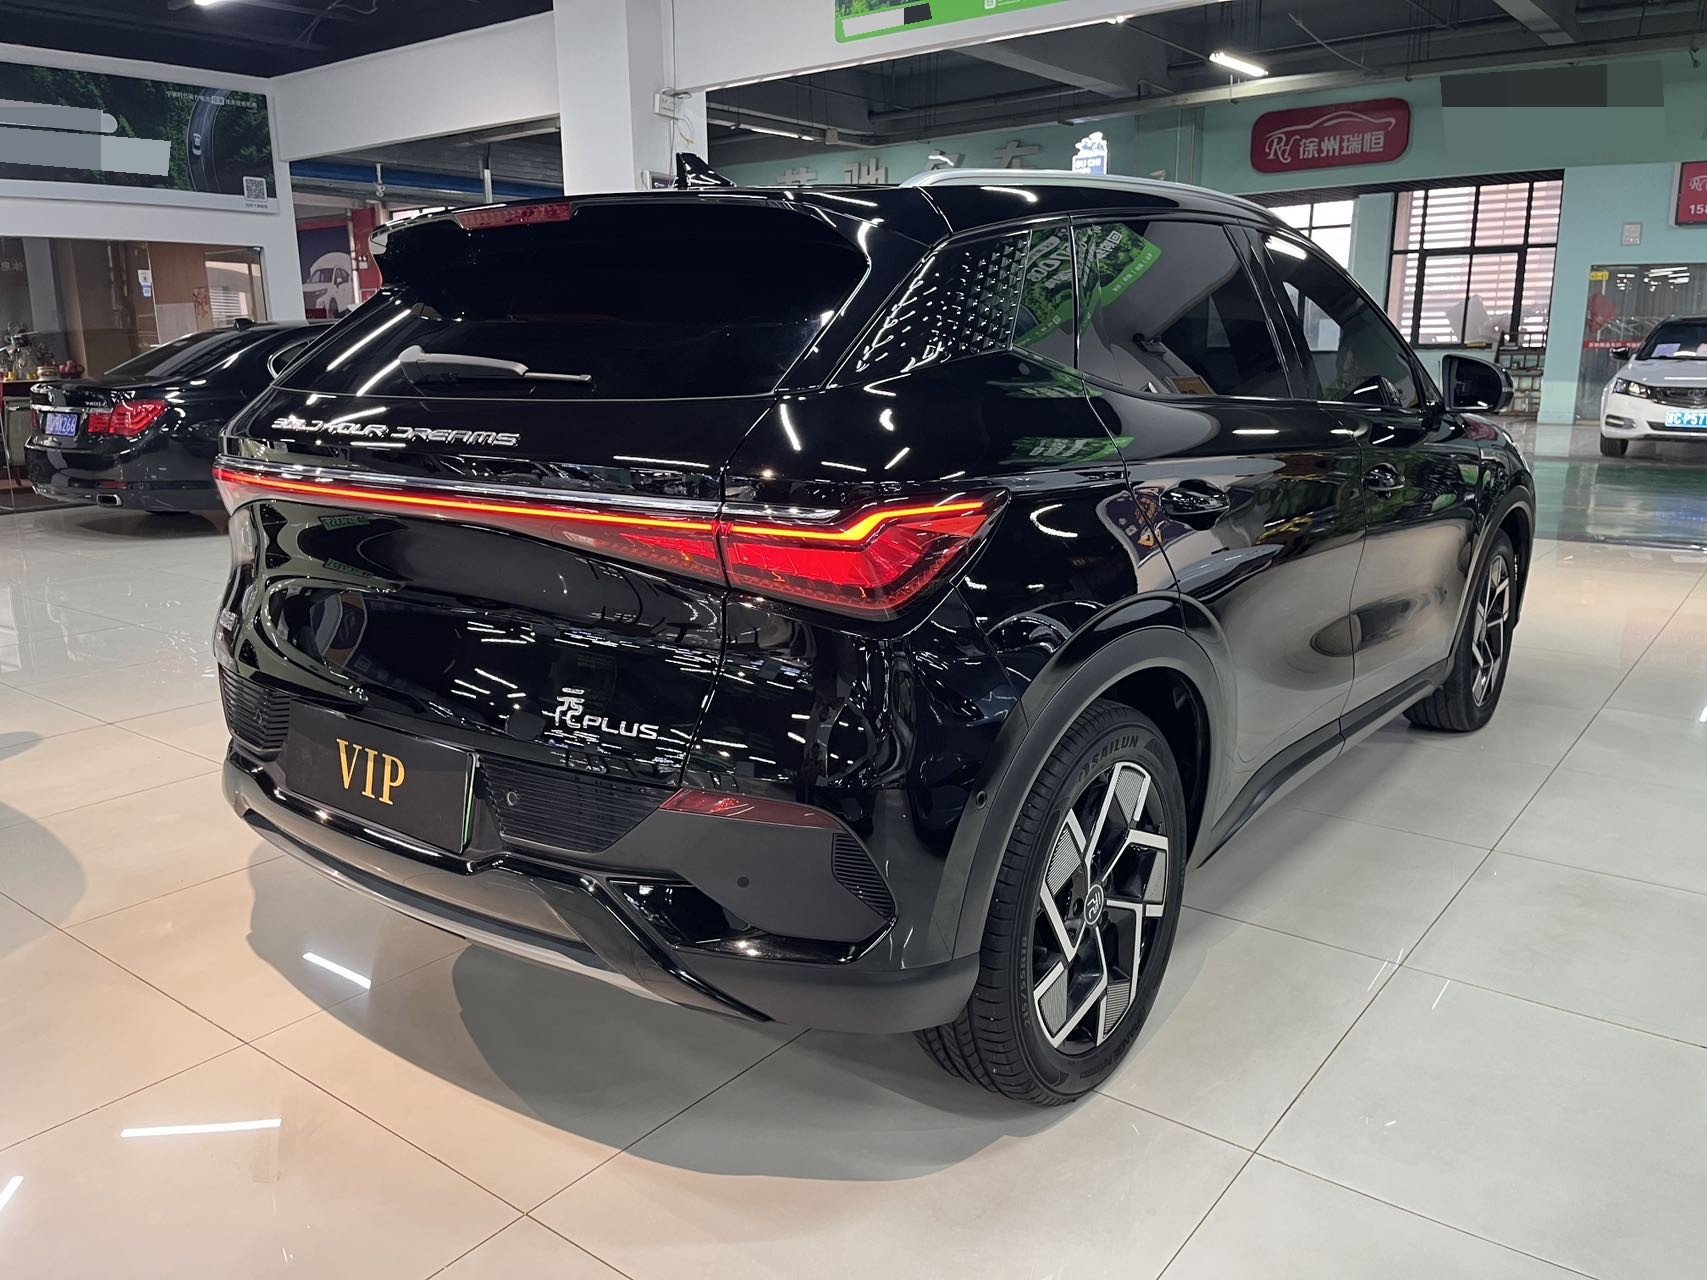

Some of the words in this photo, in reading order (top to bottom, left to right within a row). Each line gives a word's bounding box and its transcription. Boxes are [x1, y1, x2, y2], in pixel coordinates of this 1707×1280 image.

[1299, 131, 1385, 159] 徐州瑞恒
[324, 422, 389, 438] YOUR
[390, 426, 520, 447] DREAMS
[583, 714, 659, 739] PLUS
[1091, 735, 1139, 769] SAILUN
[336, 738, 405, 805] VIP
